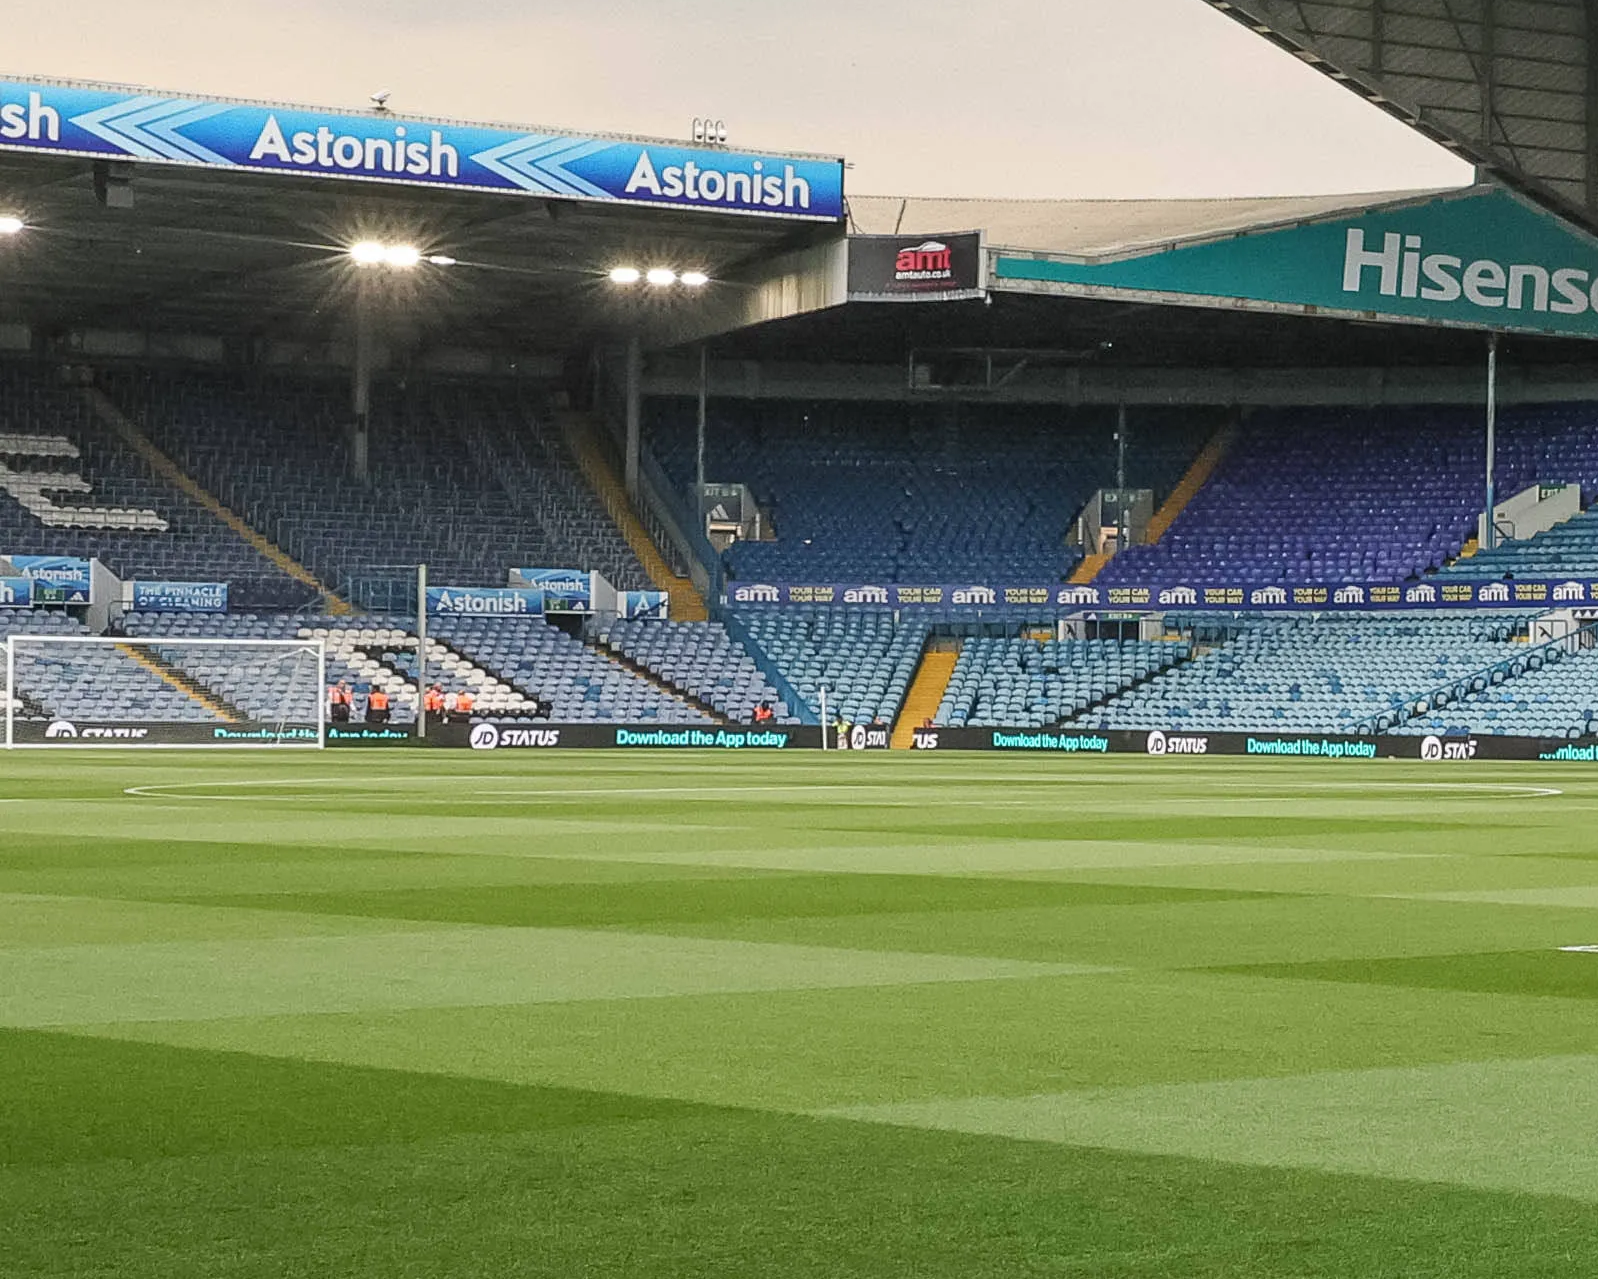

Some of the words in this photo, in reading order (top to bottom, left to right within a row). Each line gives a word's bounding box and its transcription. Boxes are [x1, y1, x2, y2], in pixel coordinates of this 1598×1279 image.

[250, 114, 458, 177] Astonish
[625, 150, 810, 209] Astonish
[22, 566, 82, 581] Astonish
[140, 586, 161, 596] THE
[165, 586, 222, 597] PINNACLE
[735, 587, 780, 602] amt
[844, 587, 889, 603] amt
[952, 588, 996, 604] amt
[1057, 588, 1100, 604] amt
[1159, 588, 1199, 604] amt
[1251, 588, 1287, 604] amt
[1333, 587, 1365, 604] amt
[1405, 586, 1437, 603] amt
[1479, 585, 1510, 602] amt
[1552, 584, 1585, 600] amt
[436, 590, 527, 612] Astonish
[500, 730, 560, 746] STATUS
[616, 729, 686, 745] Download
[690, 730, 713, 746] the
[714, 730, 744, 748] App
[746, 732, 787, 747] today
[993, 732, 1040, 747] Download
[1041, 734, 1057, 748] the
[1058, 736, 1079, 750] App
[1079, 736, 1108, 750] today
[1167, 737, 1208, 753] STATUS
[1248, 738, 1300, 754] Download
[1302, 740, 1319, 754] the
[1321, 740, 1343, 756] App
[1344, 742, 1376, 757] today
